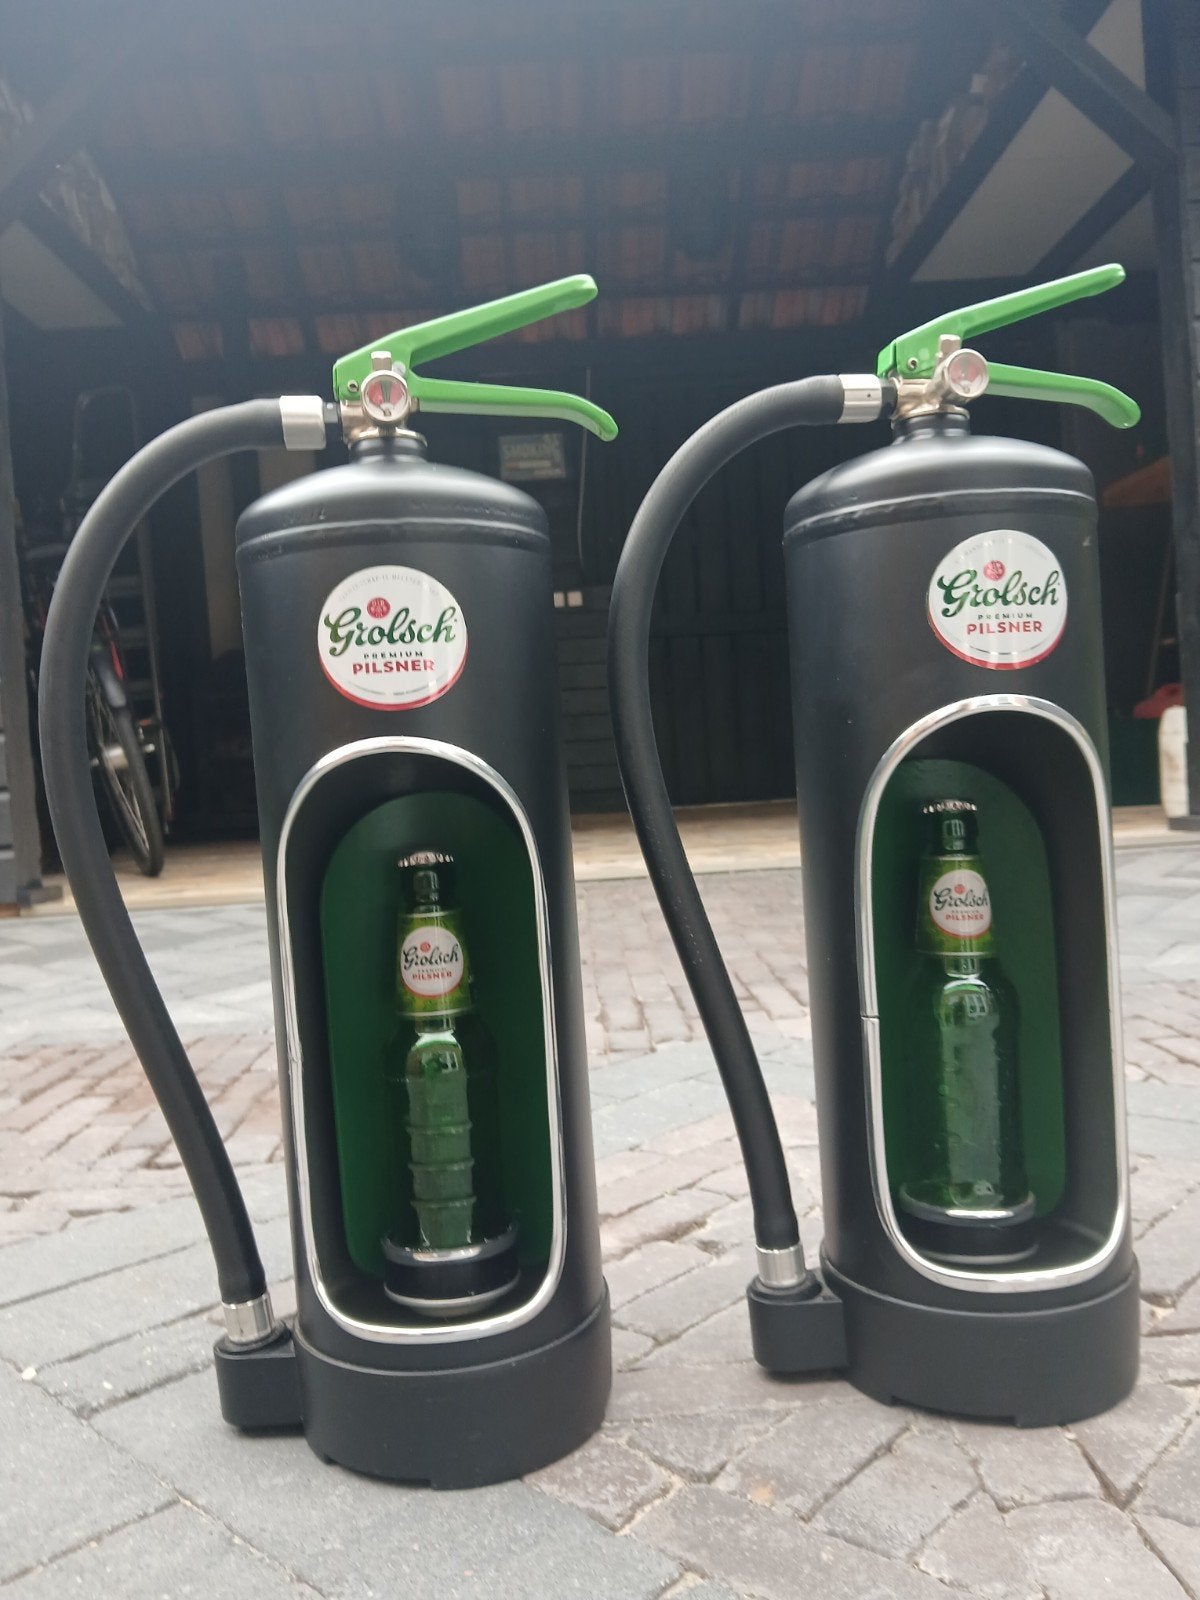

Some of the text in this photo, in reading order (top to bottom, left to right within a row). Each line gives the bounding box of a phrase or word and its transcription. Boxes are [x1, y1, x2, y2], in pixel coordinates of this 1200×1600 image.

[937, 569, 1060, 618] Grolsch
[977, 612, 1033, 620] PREMIUM
[324, 606, 457, 657] Grolsch
[966, 621, 1043, 635] PILSNER
[363, 650, 424, 660] PREMIUM
[352, 659, 436, 675] PILSNER
[402, 943, 459, 971] Grolsch
